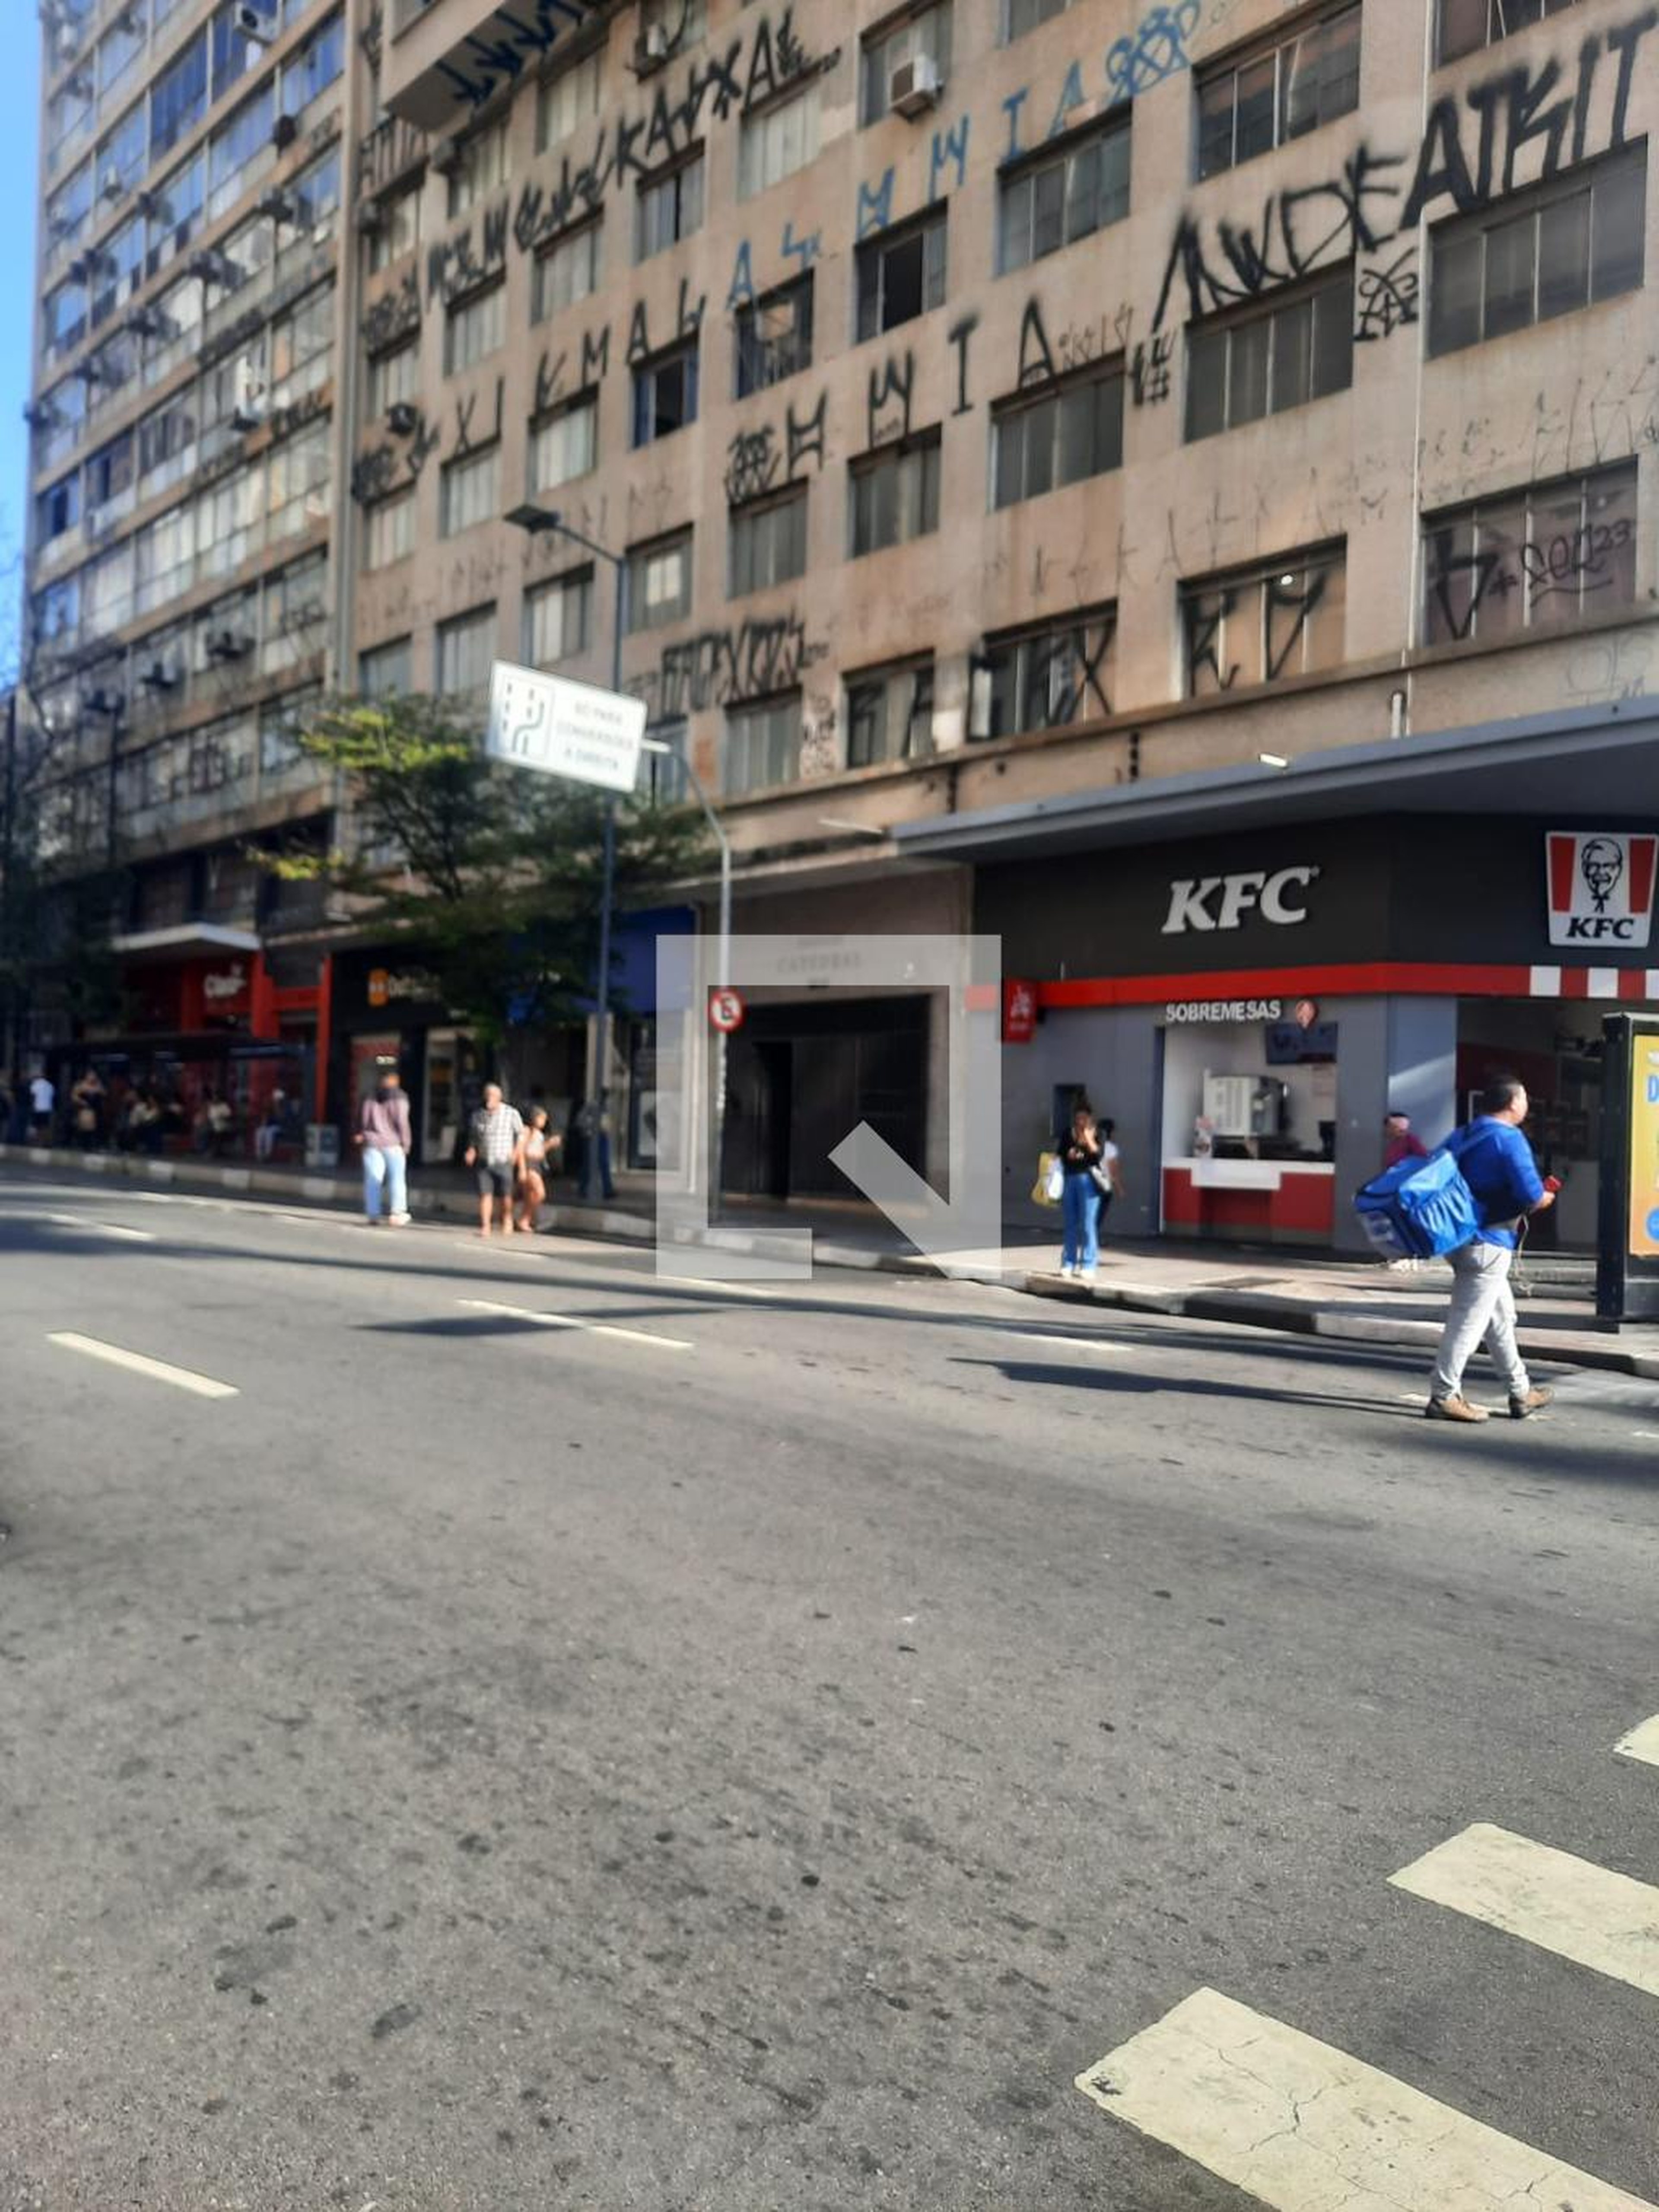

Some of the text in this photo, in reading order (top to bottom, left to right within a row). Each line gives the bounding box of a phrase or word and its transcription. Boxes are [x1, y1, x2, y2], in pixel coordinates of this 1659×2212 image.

[1161, 866, 1311, 934] KFC
[1566, 917, 1635, 939] KFC
[1166, 999, 1282, 1022] SOBREMESAS
